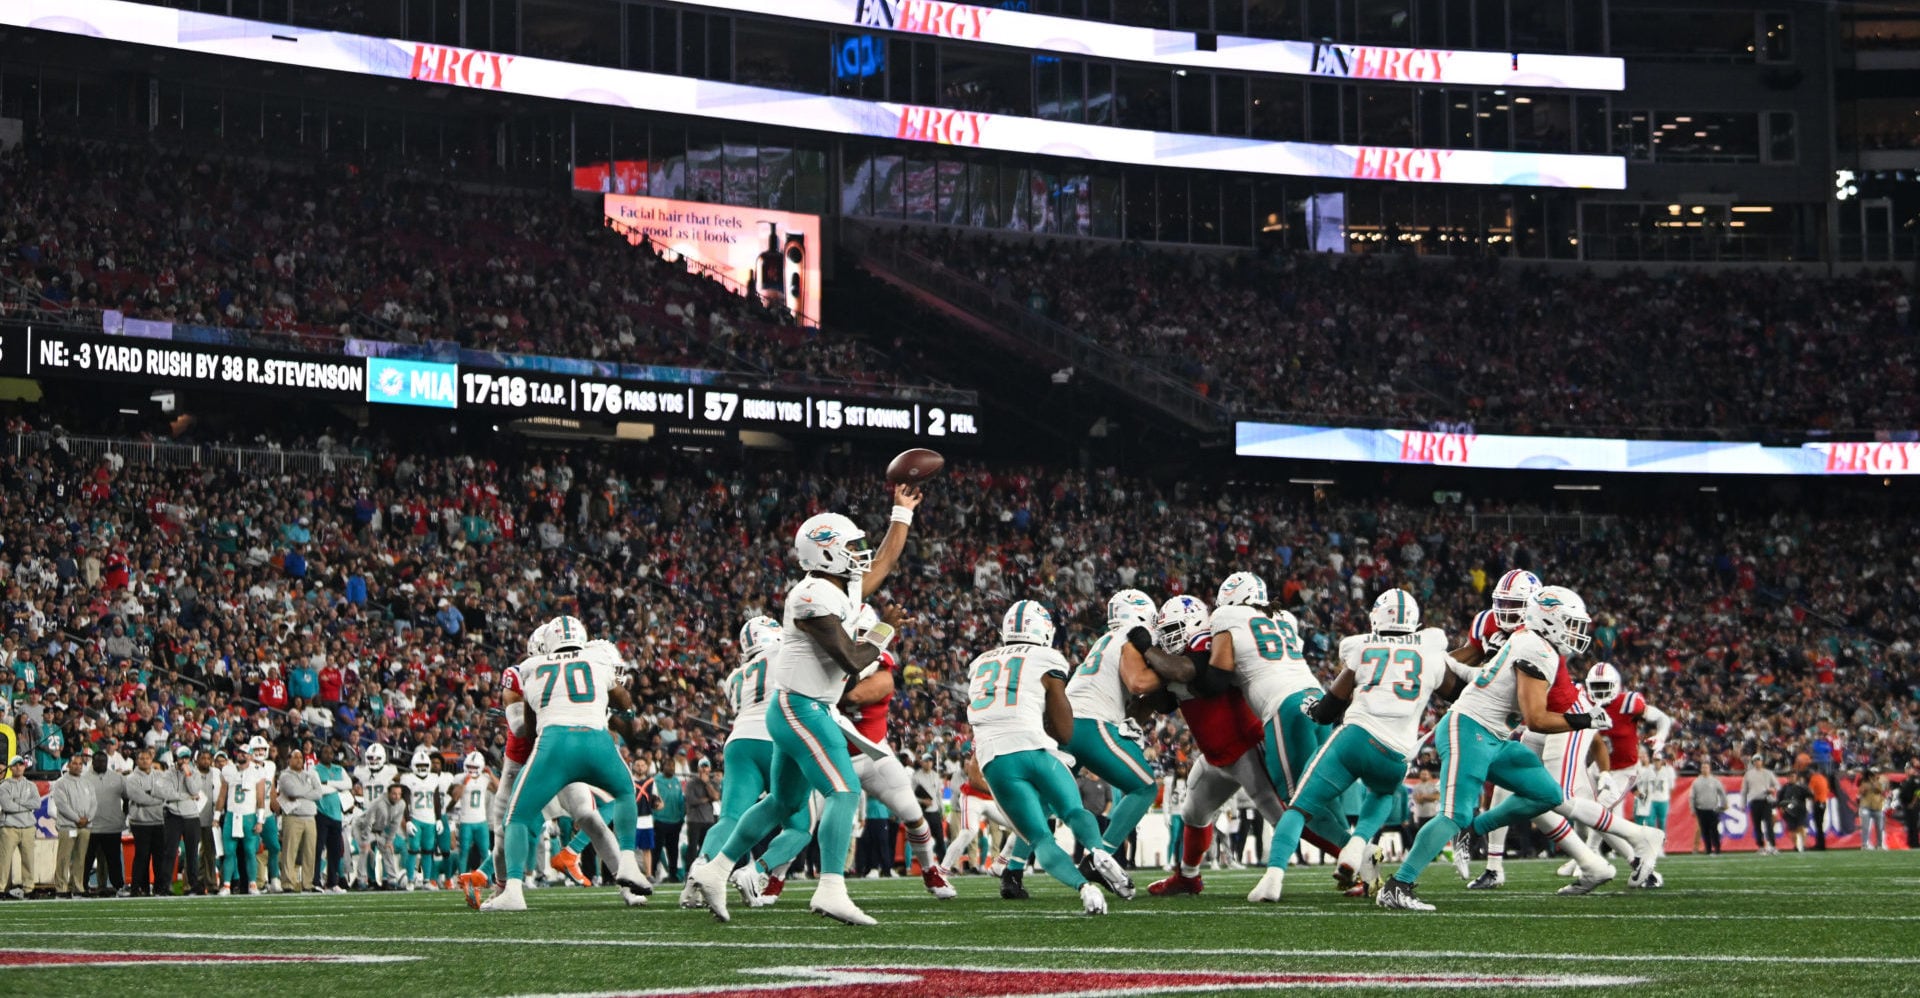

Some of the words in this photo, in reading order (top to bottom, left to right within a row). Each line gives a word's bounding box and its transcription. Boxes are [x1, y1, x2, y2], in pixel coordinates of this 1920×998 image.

[855, 0, 992, 40] ENERGY
[409, 42, 515, 91] ERGY
[1310, 43, 1454, 82] ENERGY
[896, 105, 990, 145] ERGY
[1353, 147, 1454, 181] ERGY
[620, 205, 655, 219] Facial
[658, 208, 683, 221] hair
[686, 211, 710, 226] that
[714, 214, 742, 229] feels
[642, 226, 673, 239] good
[676, 229, 689, 239] as
[692, 230, 700, 240] it
[703, 229, 737, 244] looks
[40, 340, 69, 367] NE:
[73, 343, 91, 369] -3
[95, 344, 142, 373] YARD
[147, 349, 192, 377] RUSH
[196, 353, 218, 379] BY
[222, 354, 243, 382] 38
[247, 357, 363, 391] R.STEVENSON
[410, 370, 454, 401] MIA
[463, 373, 527, 407] 17:18
[529, 382, 566, 405] T.O.P.
[580, 382, 622, 414] 176
[624, 390, 657, 412] PASS
[658, 392, 684, 413] YDS
[704, 391, 738, 421] 57
[743, 399, 776, 420] RUSH
[777, 401, 803, 422] YDS
[816, 400, 842, 429] 15
[844, 406, 866, 426] 1ST
[867, 408, 911, 429] DOWNS
[928, 408, 946, 436] 2
[950, 413, 977, 434] PEN.
[1400, 430, 1477, 464] ERGY
[1825, 442, 1920, 471] ERGY
[1363, 634, 1421, 646] JACKSON
[272, 685, 283, 699] 12
[535, 661, 596, 709] 70
[730, 657, 768, 710] 77
[968, 656, 1025, 712] 31
[1360, 647, 1422, 701] 73
